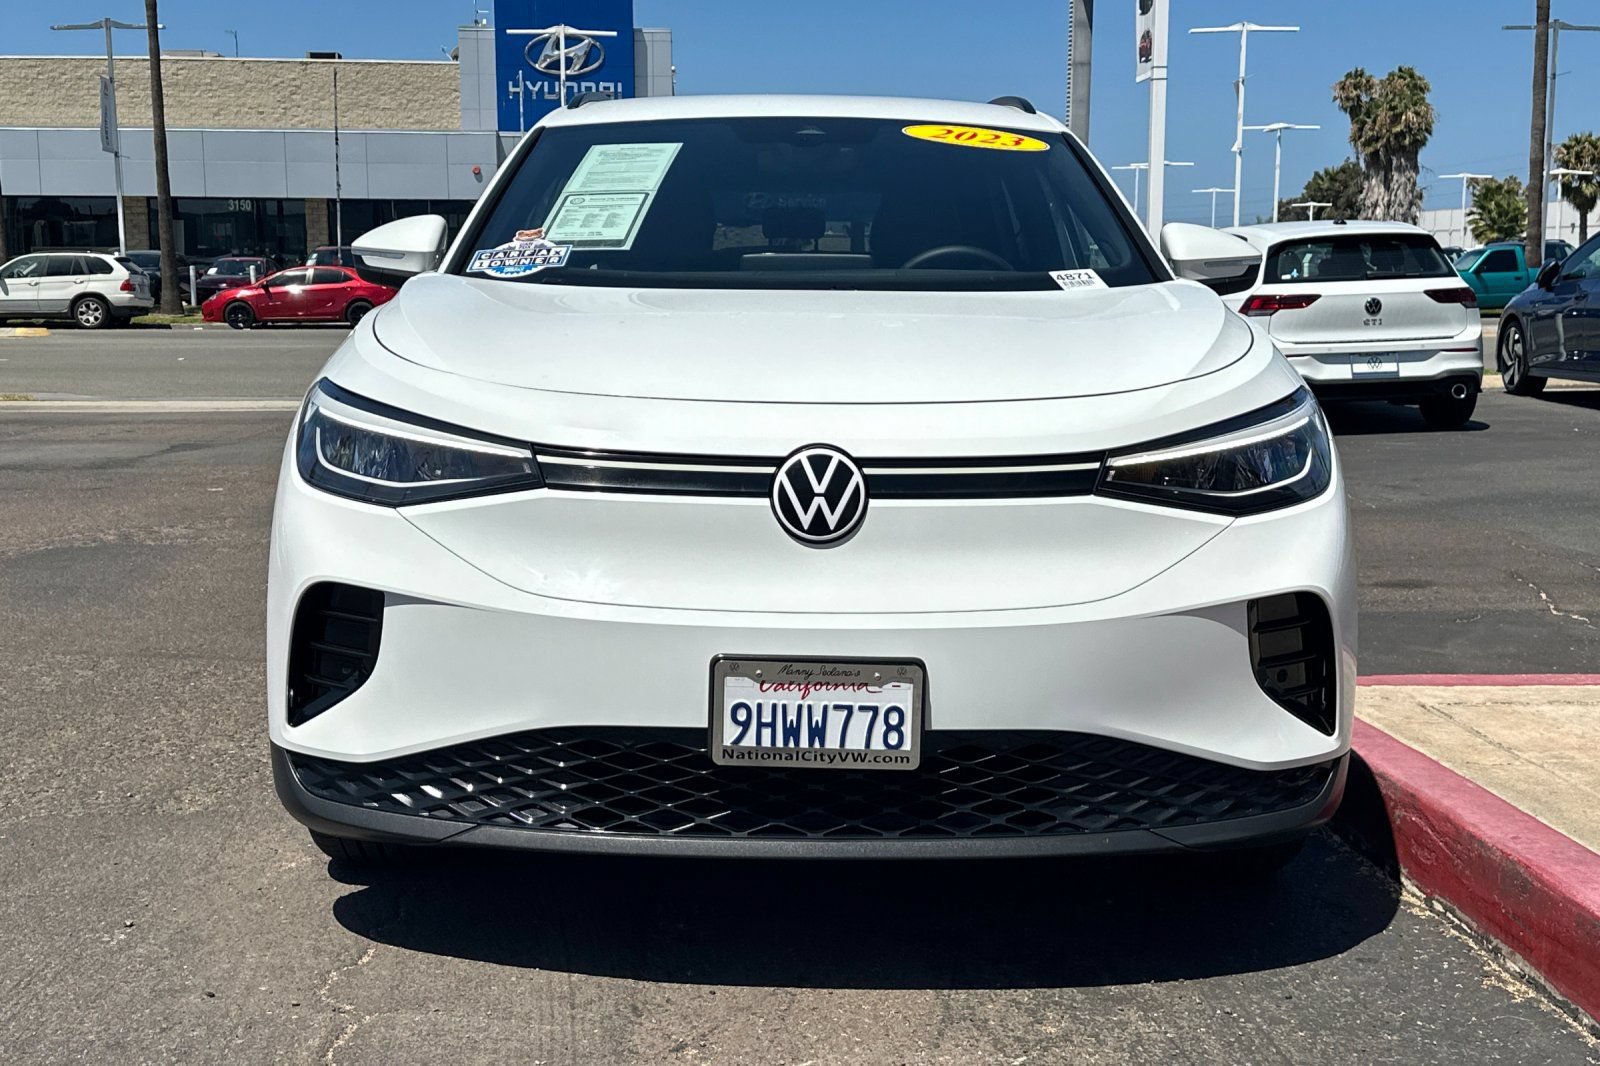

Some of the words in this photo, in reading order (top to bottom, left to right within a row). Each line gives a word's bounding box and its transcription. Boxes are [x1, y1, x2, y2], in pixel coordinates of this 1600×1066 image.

[508, 81, 623, 100] HYUNDAI
[930, 128, 1024, 147] 2023
[228, 199, 252, 212] 3150
[480, 247, 563, 260] CARFAX
[490, 256, 561, 267] OWNER
[1056, 272, 1094, 281] 4871
[777, 663, 814, 681] Manny
[759, 680, 882, 700] California
[730, 702, 905, 750] 9HWW778
[721, 749, 910, 765] NationalCityVW.com
